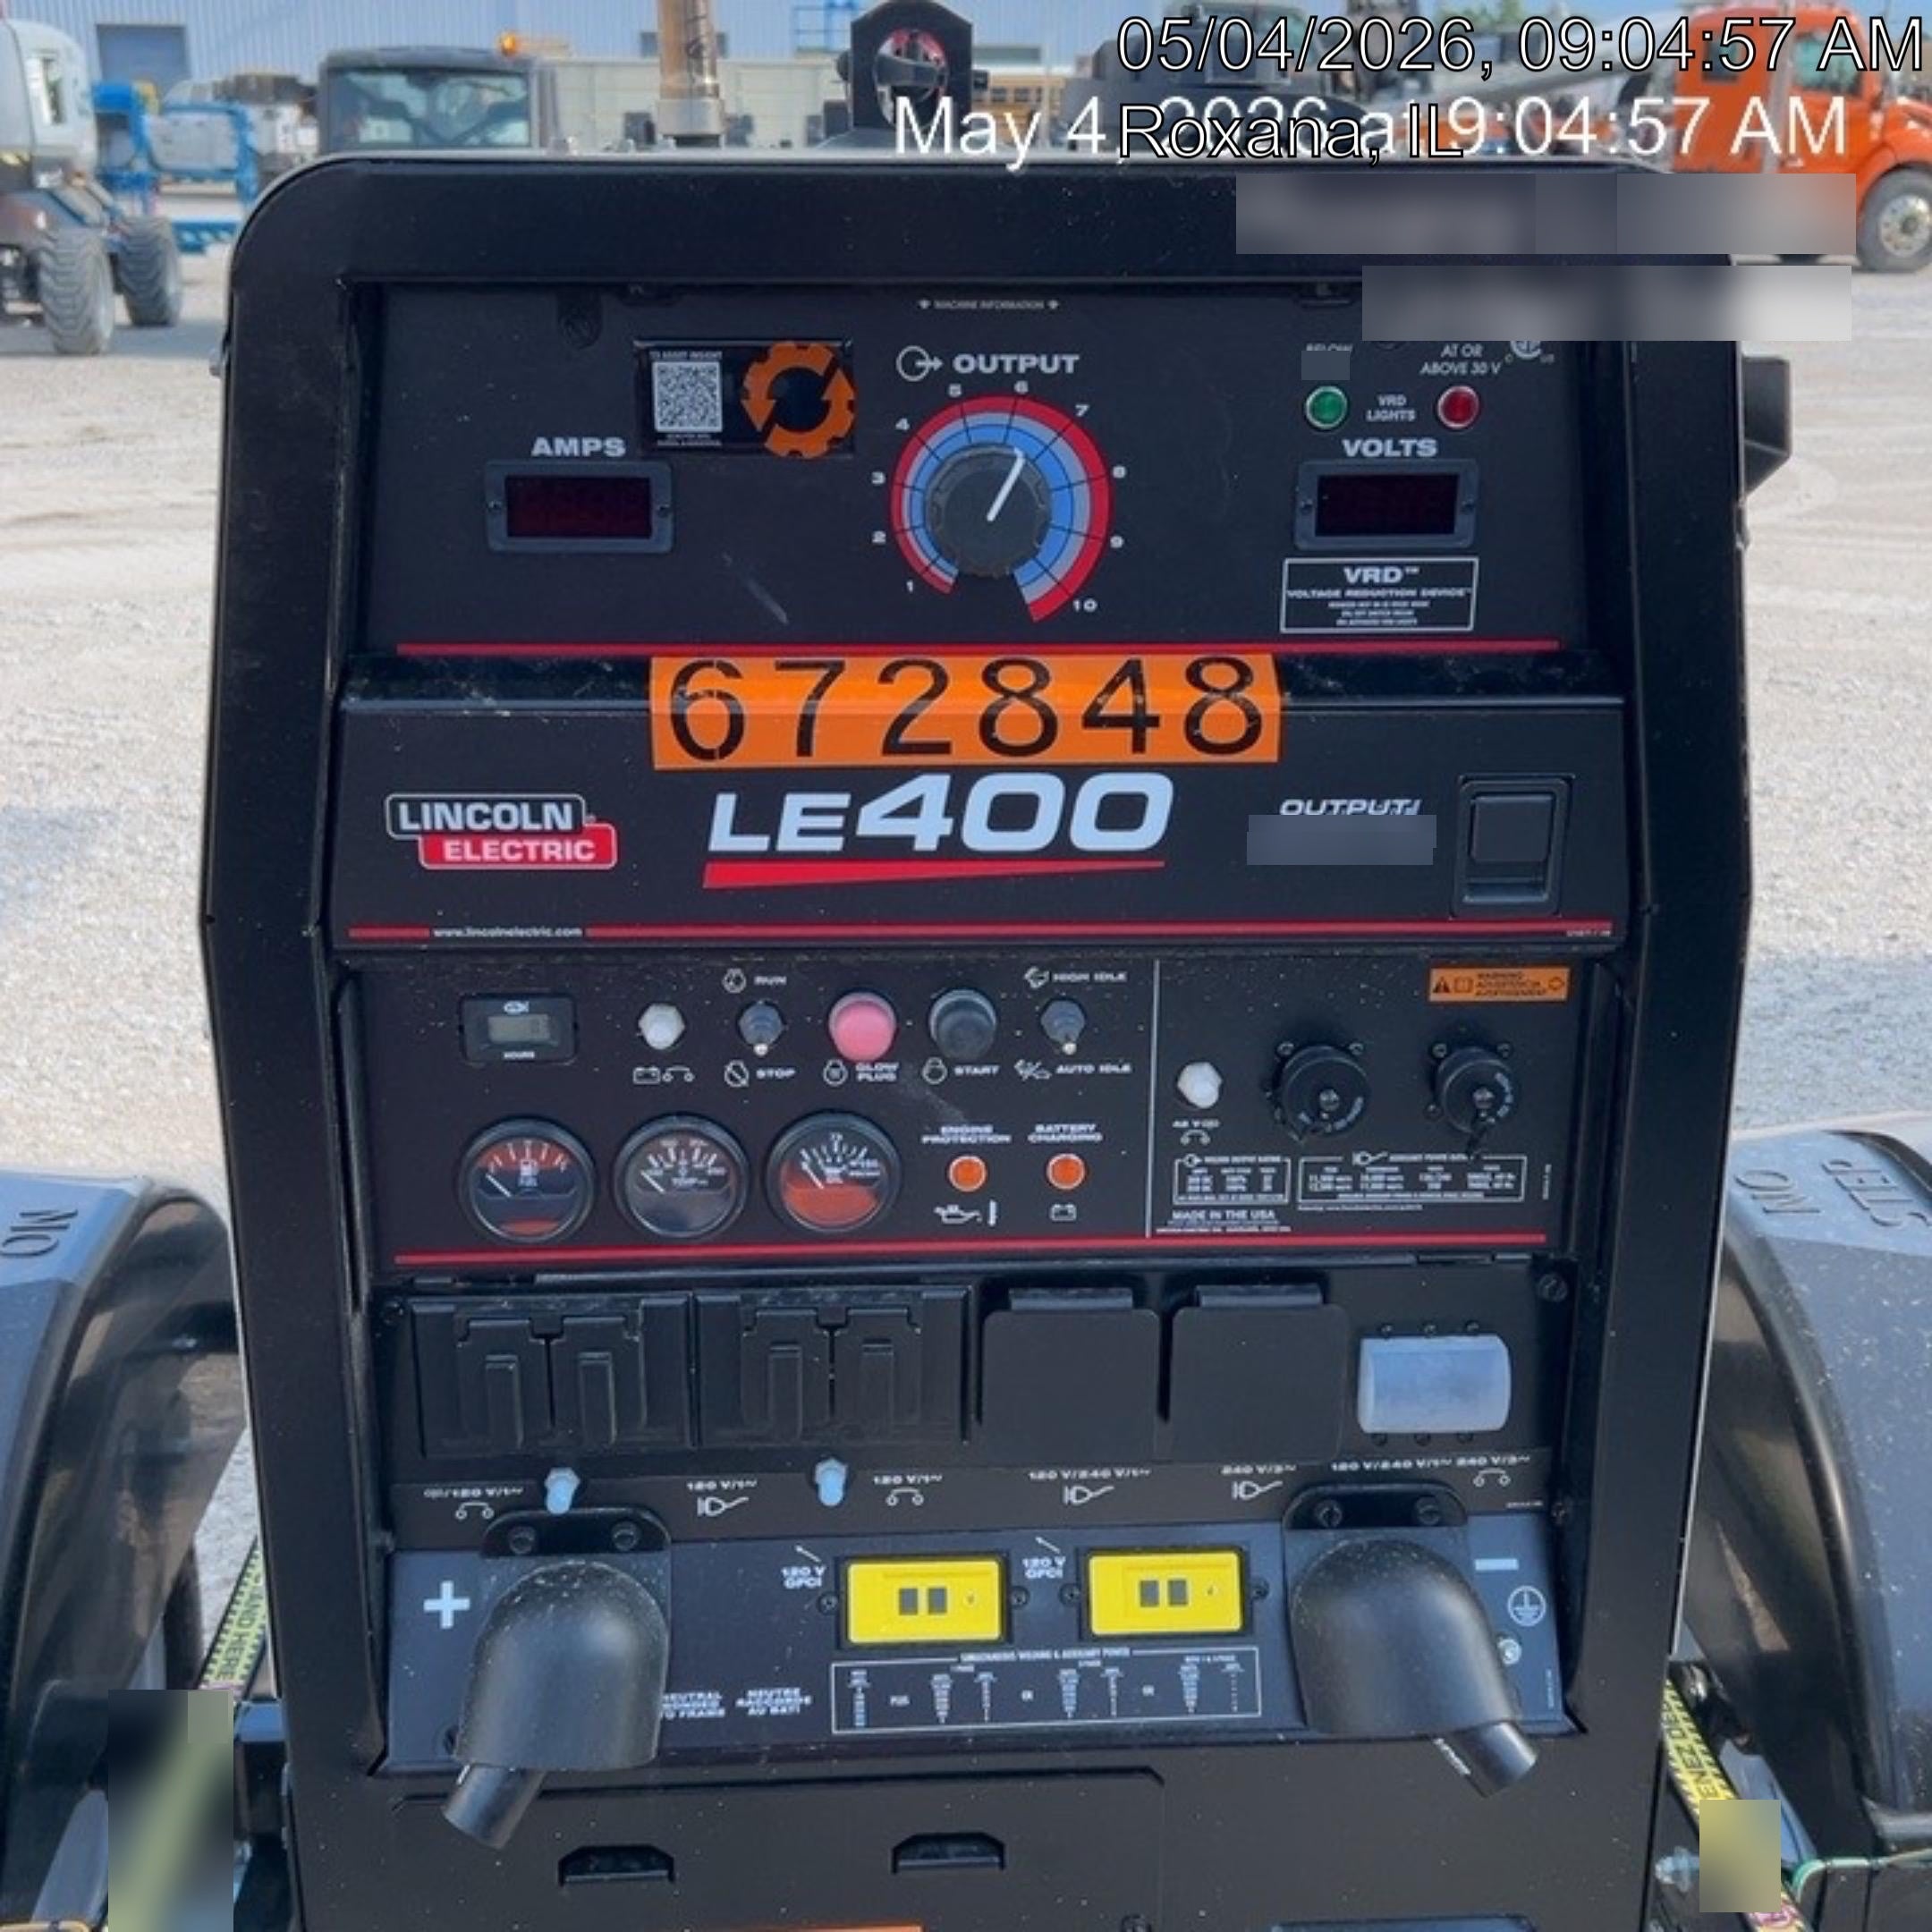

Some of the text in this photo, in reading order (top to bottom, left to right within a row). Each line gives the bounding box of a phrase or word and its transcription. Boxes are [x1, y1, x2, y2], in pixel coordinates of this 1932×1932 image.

[1441, 343, 1462, 357] AT
[952, 353, 1080, 374] OUTPUT
[1419, 361, 1467, 376] ABOVE
[1490, 360, 1503, 375] V
[948, 383, 962, 397] 5
[1014, 380, 1029, 394] 6
[1377, 394, 1407, 407] VRD
[1075, 403, 1089, 417] 7
[1366, 409, 1416, 422] LIGHTS
[895, 418, 910, 431] 4
[530, 437, 627, 458] AMPS
[1343, 438, 1438, 458] VOLTS
[871, 470, 886, 485] 3
[1113, 465, 1127, 479] 8
[871, 530, 887, 545] 2
[1109, 535, 1124, 548] 9
[906, 580, 914, 593] 1
[1072, 598, 1098, 613] 10
[669, 656, 1264, 760] 672848
[398, 801, 573, 831] LINCOLN
[708, 772, 1175, 853] LE400
[442, 838, 597, 862] ELECTRIC
[433, 926, 583, 938] www.lincolnelectric.com
[756, 1066, 797, 1079] STOP
[953, 1064, 1001, 1075] START
[1224, 1208, 1248, 1219] THE
